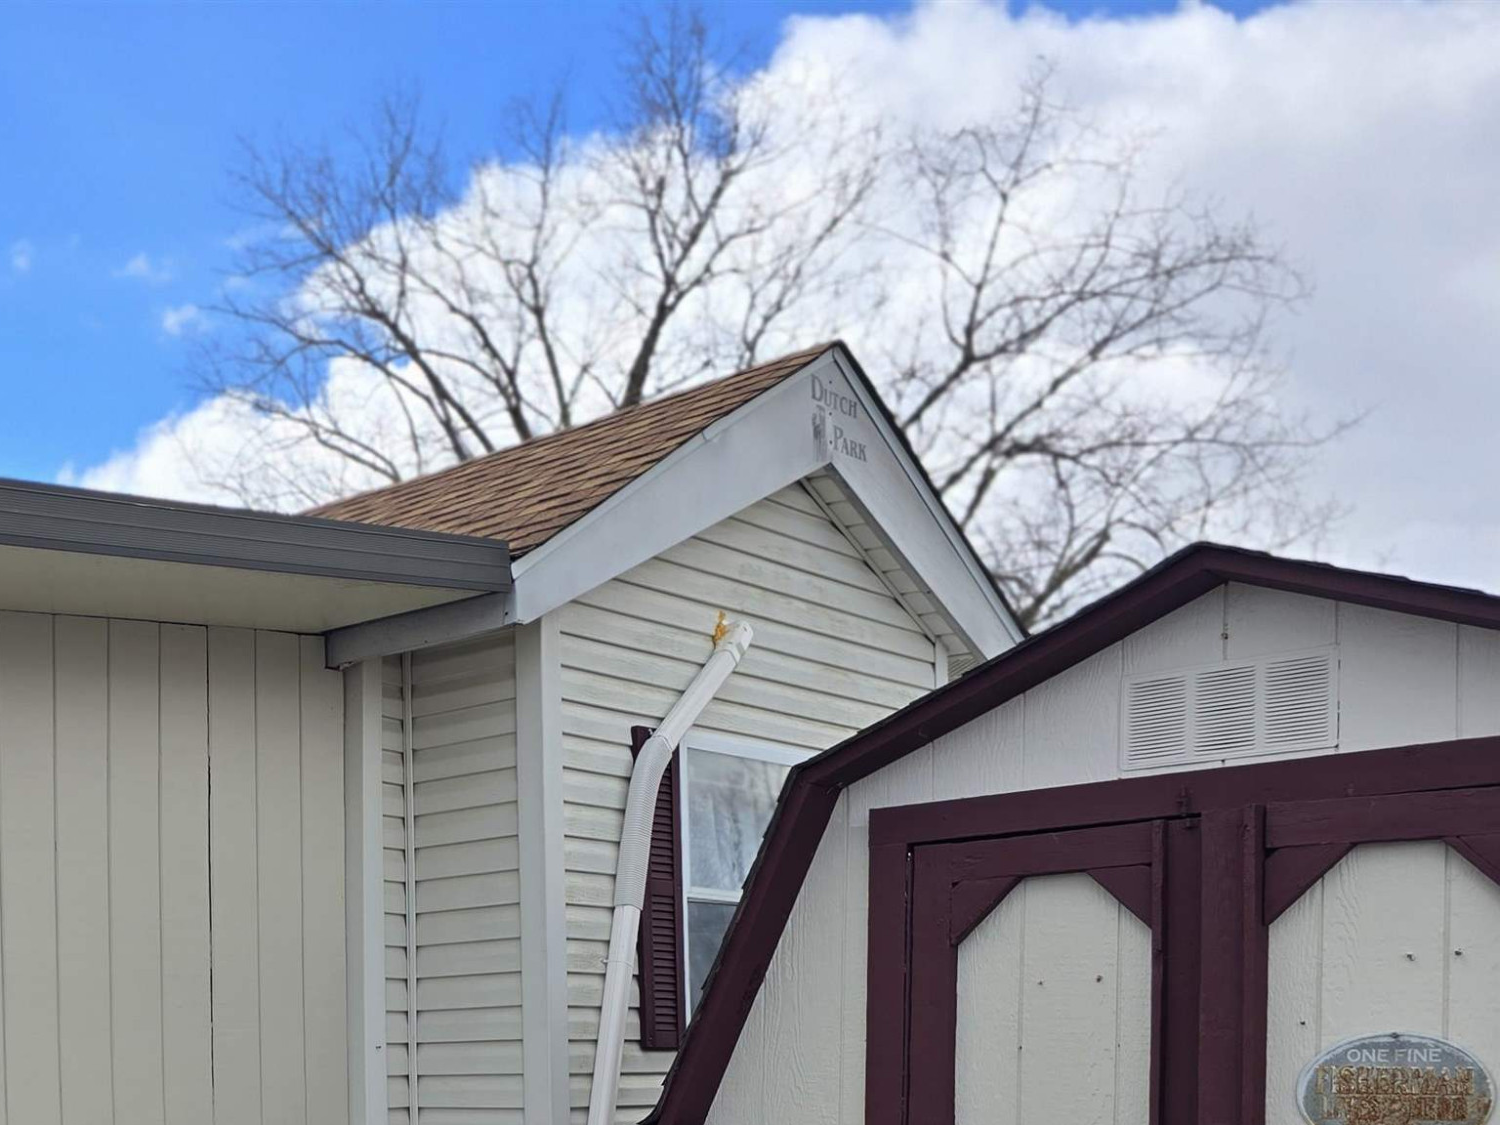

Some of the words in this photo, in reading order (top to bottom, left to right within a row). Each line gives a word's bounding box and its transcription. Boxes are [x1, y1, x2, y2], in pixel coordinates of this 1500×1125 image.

[811, 374, 858, 419] DUTCH
[832, 425, 867, 462] PARK
[1346, 1048, 1389, 1063] ONE
[1394, 1048, 1442, 1063] FINE
